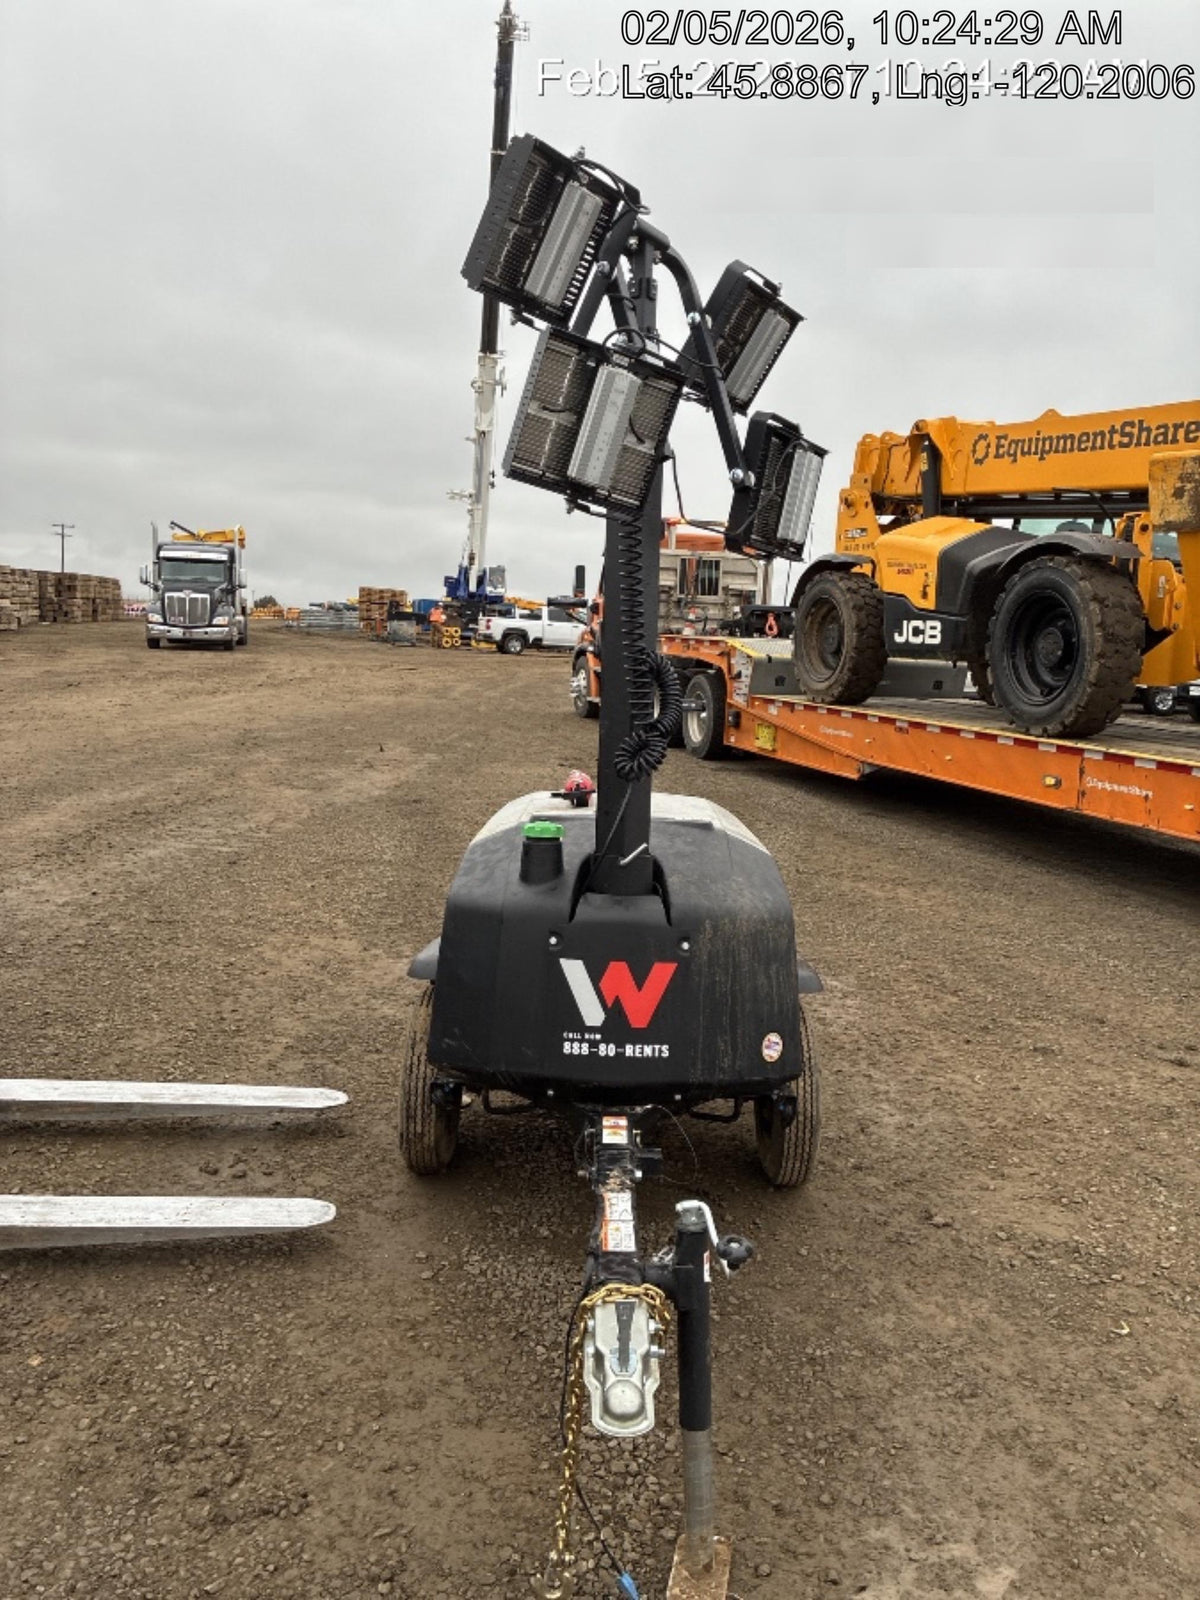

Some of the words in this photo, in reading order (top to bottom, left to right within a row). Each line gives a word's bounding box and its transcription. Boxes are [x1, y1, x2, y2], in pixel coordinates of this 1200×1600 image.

[993, 419, 1200, 462] EquipmentShare
[893, 619, 942, 645] JCB
[562, 1040, 670, 1059] 888-80-RENTS
